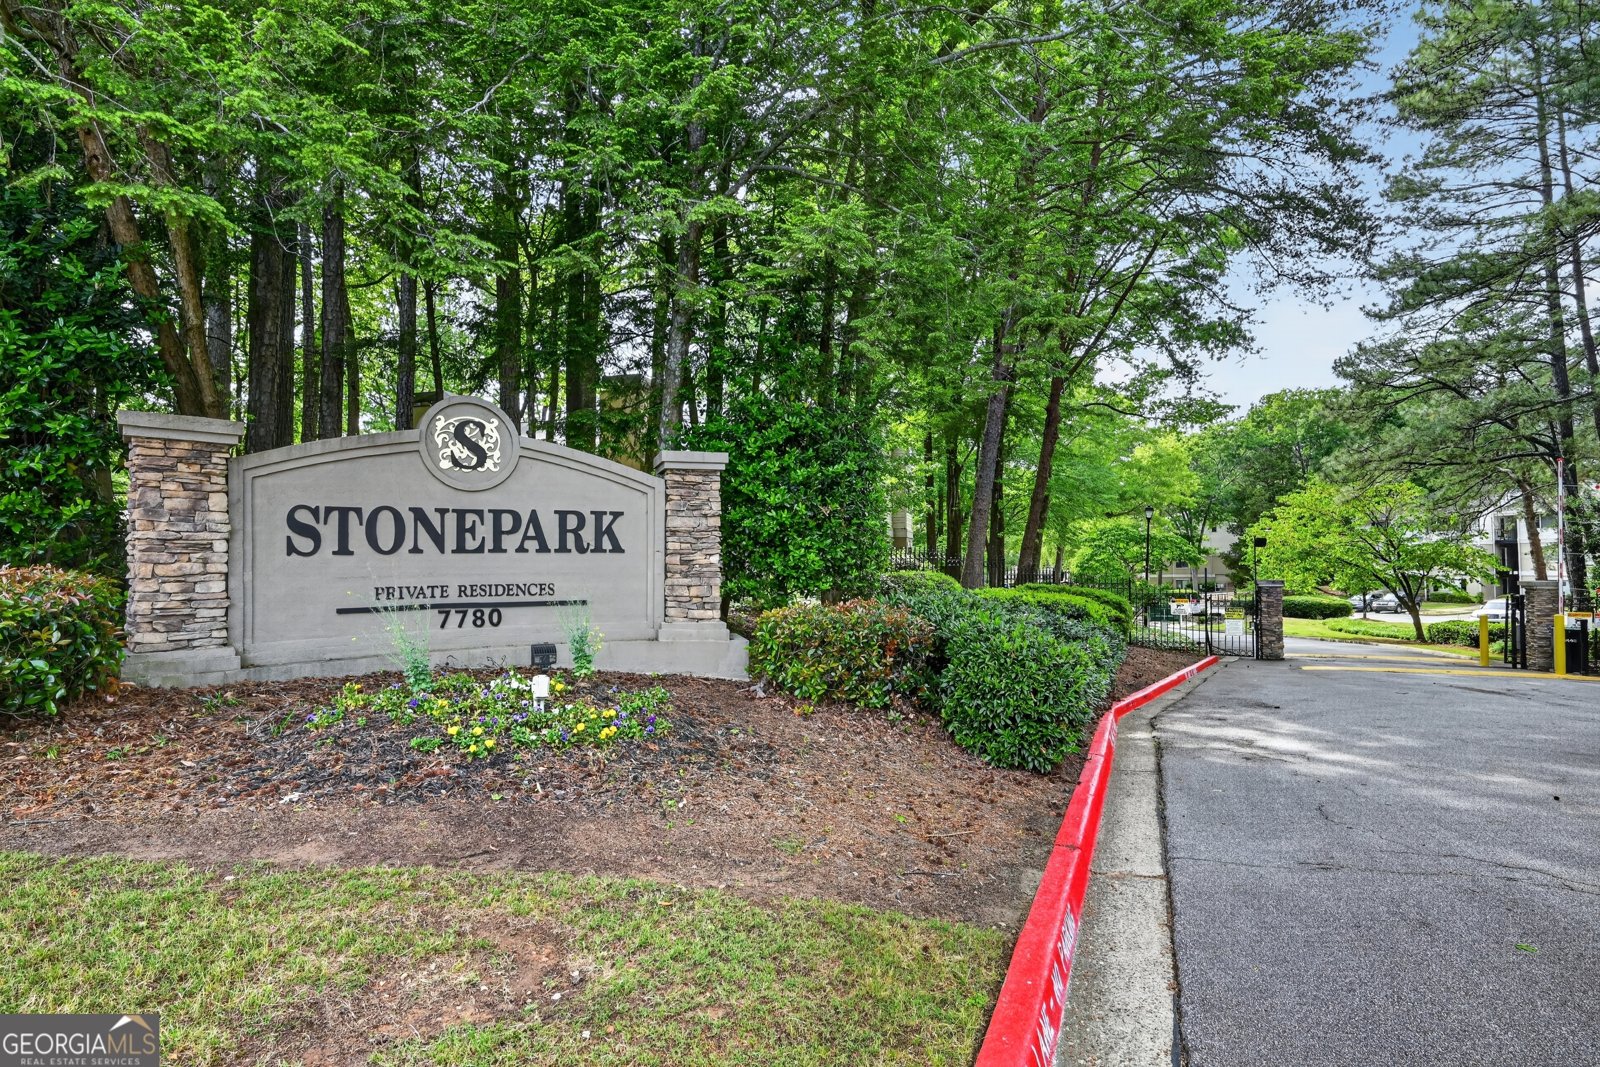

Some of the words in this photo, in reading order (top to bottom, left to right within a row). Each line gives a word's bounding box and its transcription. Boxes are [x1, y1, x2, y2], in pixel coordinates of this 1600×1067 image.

[286, 504, 626, 557] STONEPARK
[374, 584, 450, 600] PRIVATE
[457, 582, 556, 598] RESIDENCES
[437, 608, 502, 629] 7780
